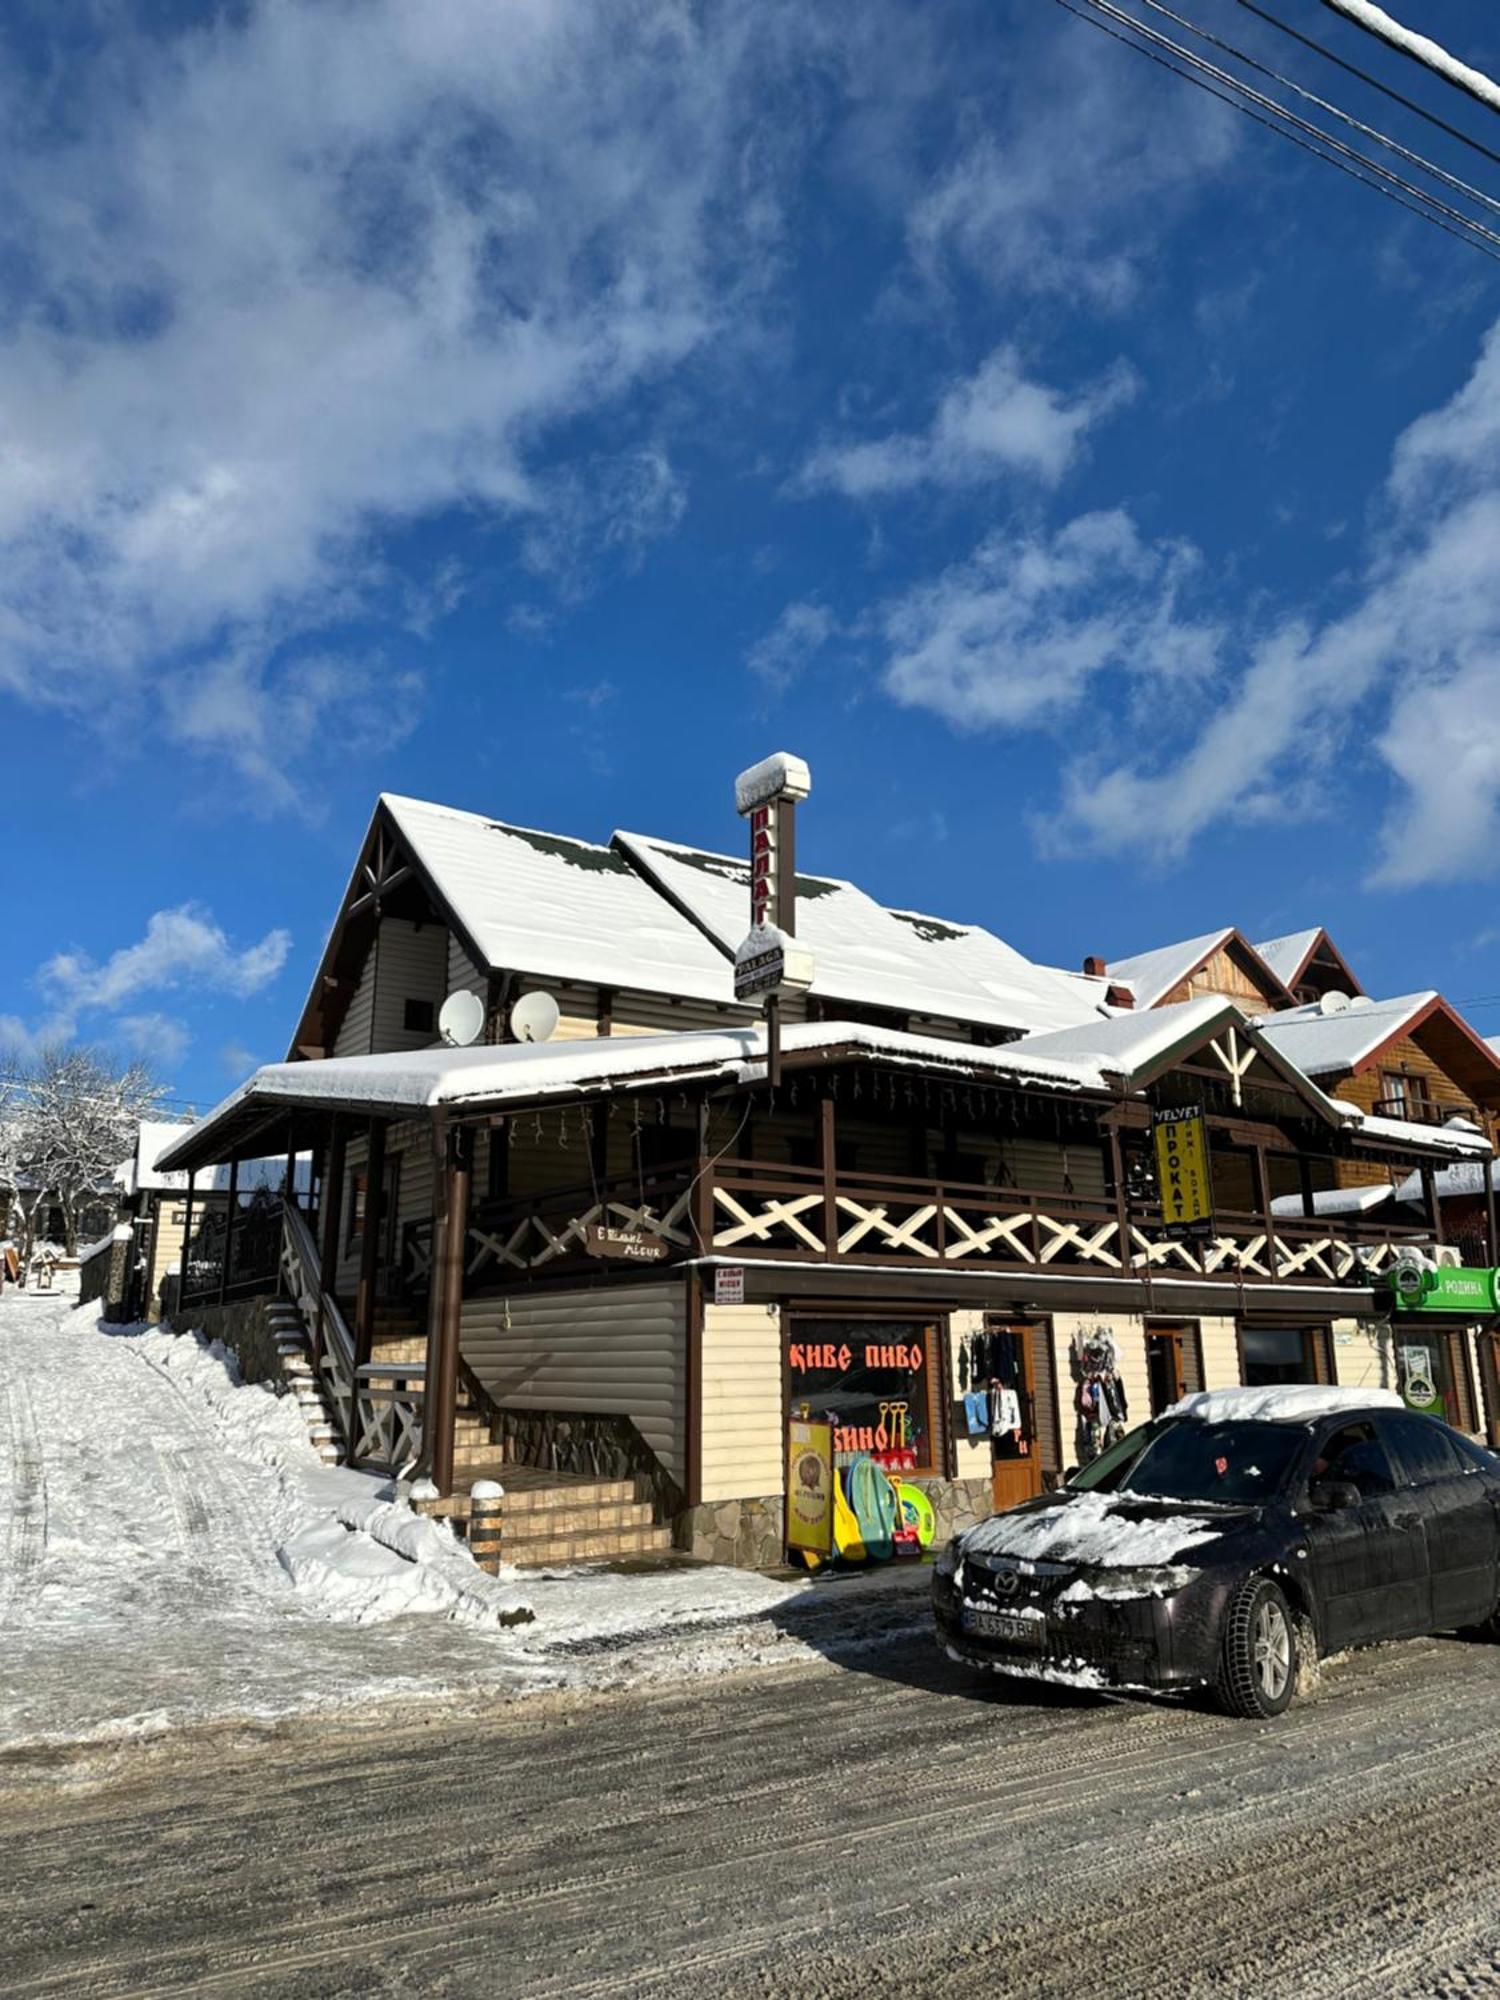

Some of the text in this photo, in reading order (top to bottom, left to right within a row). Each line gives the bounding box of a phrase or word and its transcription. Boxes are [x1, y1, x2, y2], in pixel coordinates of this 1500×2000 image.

[1155, 1105, 1199, 1121] VELVET
[1166, 1125, 1183, 1217] ПРОКАТ
[865, 1344, 922, 1371] ПИВО
